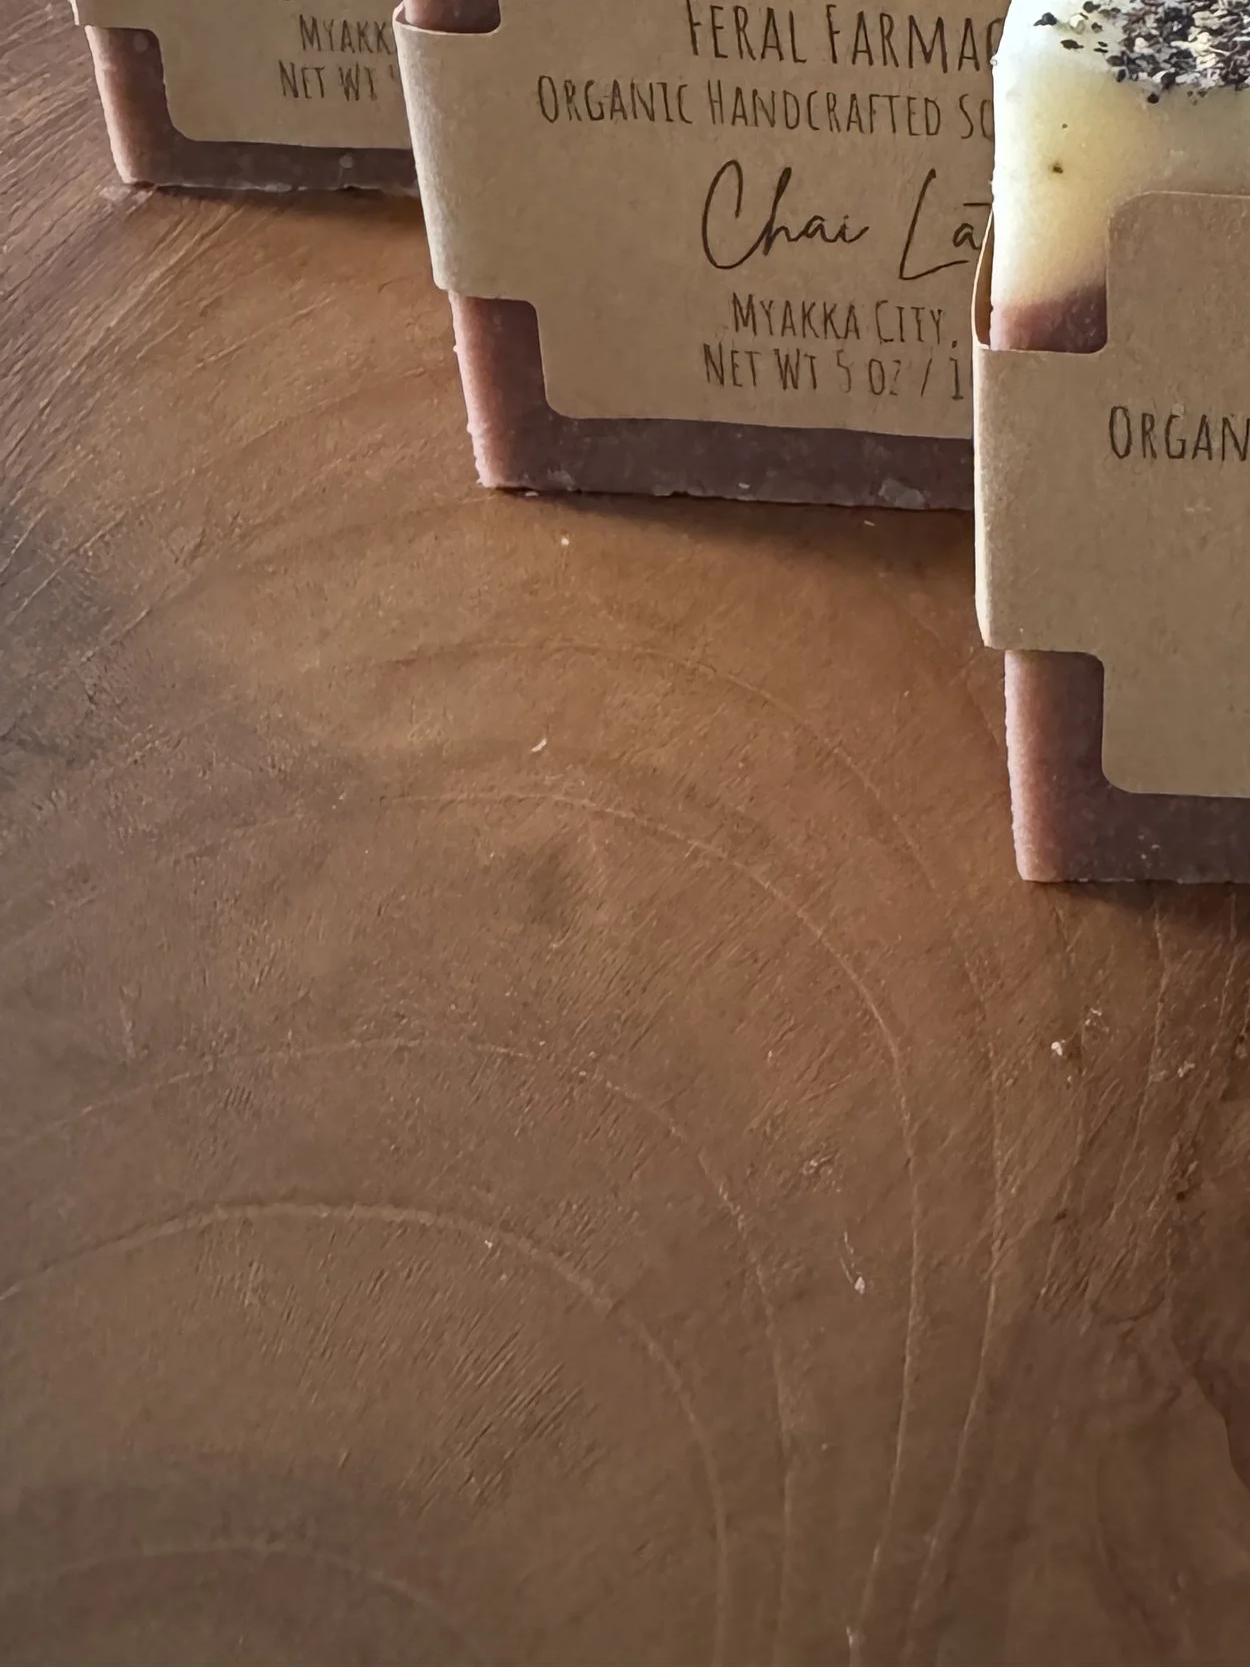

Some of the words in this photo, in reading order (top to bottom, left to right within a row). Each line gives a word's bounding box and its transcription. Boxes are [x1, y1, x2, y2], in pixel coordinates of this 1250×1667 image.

[298, 13, 393, 56] MYAKK
[277, 59, 326, 100] NET
[536, 74, 693, 125] ORGANIC
[706, 79, 942, 137] HANDCRAFTED
[700, 158, 871, 271] Chai
[897, 167, 991, 283] La
[730, 291, 861, 341] MYAKKA
[702, 341, 761, 388] NET
[772, 347, 818, 391] WT
[835, 348, 852, 393] 5
